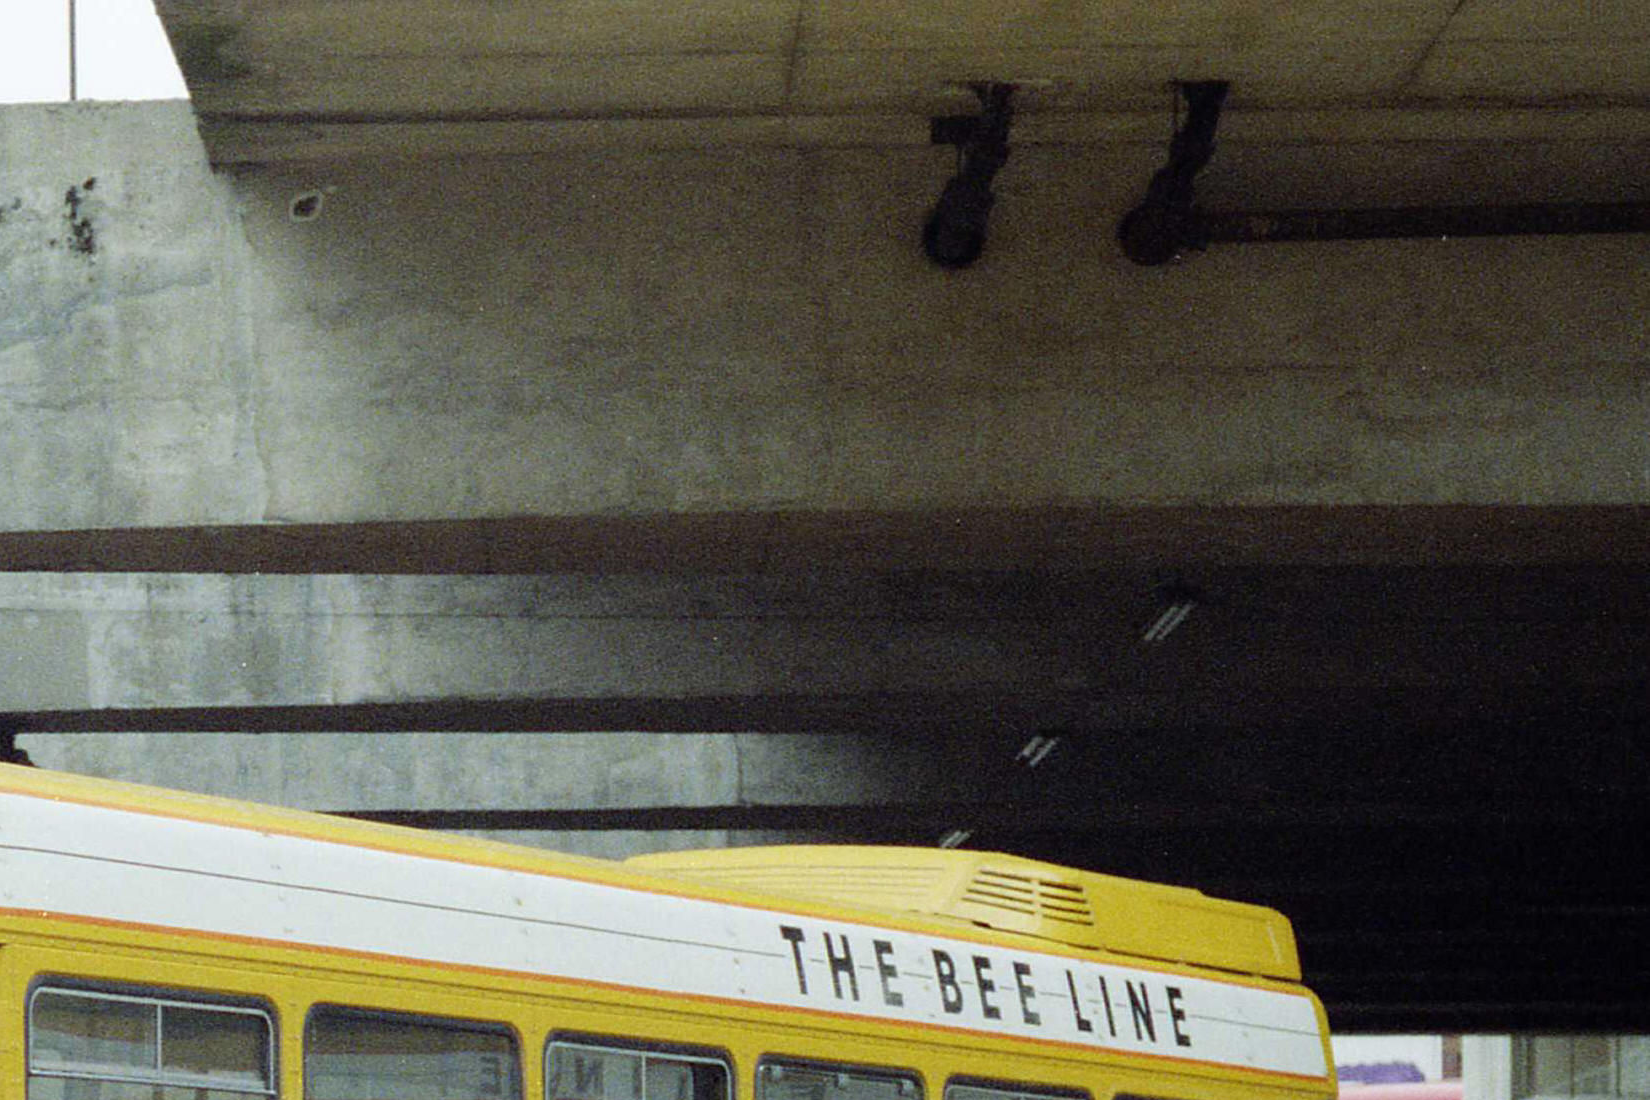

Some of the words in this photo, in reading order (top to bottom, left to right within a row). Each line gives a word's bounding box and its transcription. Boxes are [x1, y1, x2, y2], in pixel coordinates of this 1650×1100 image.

[779, 924, 904, 1007] THE
[931, 947, 1042, 1026] BEE
[1065, 968, 1192, 1047] LINE
